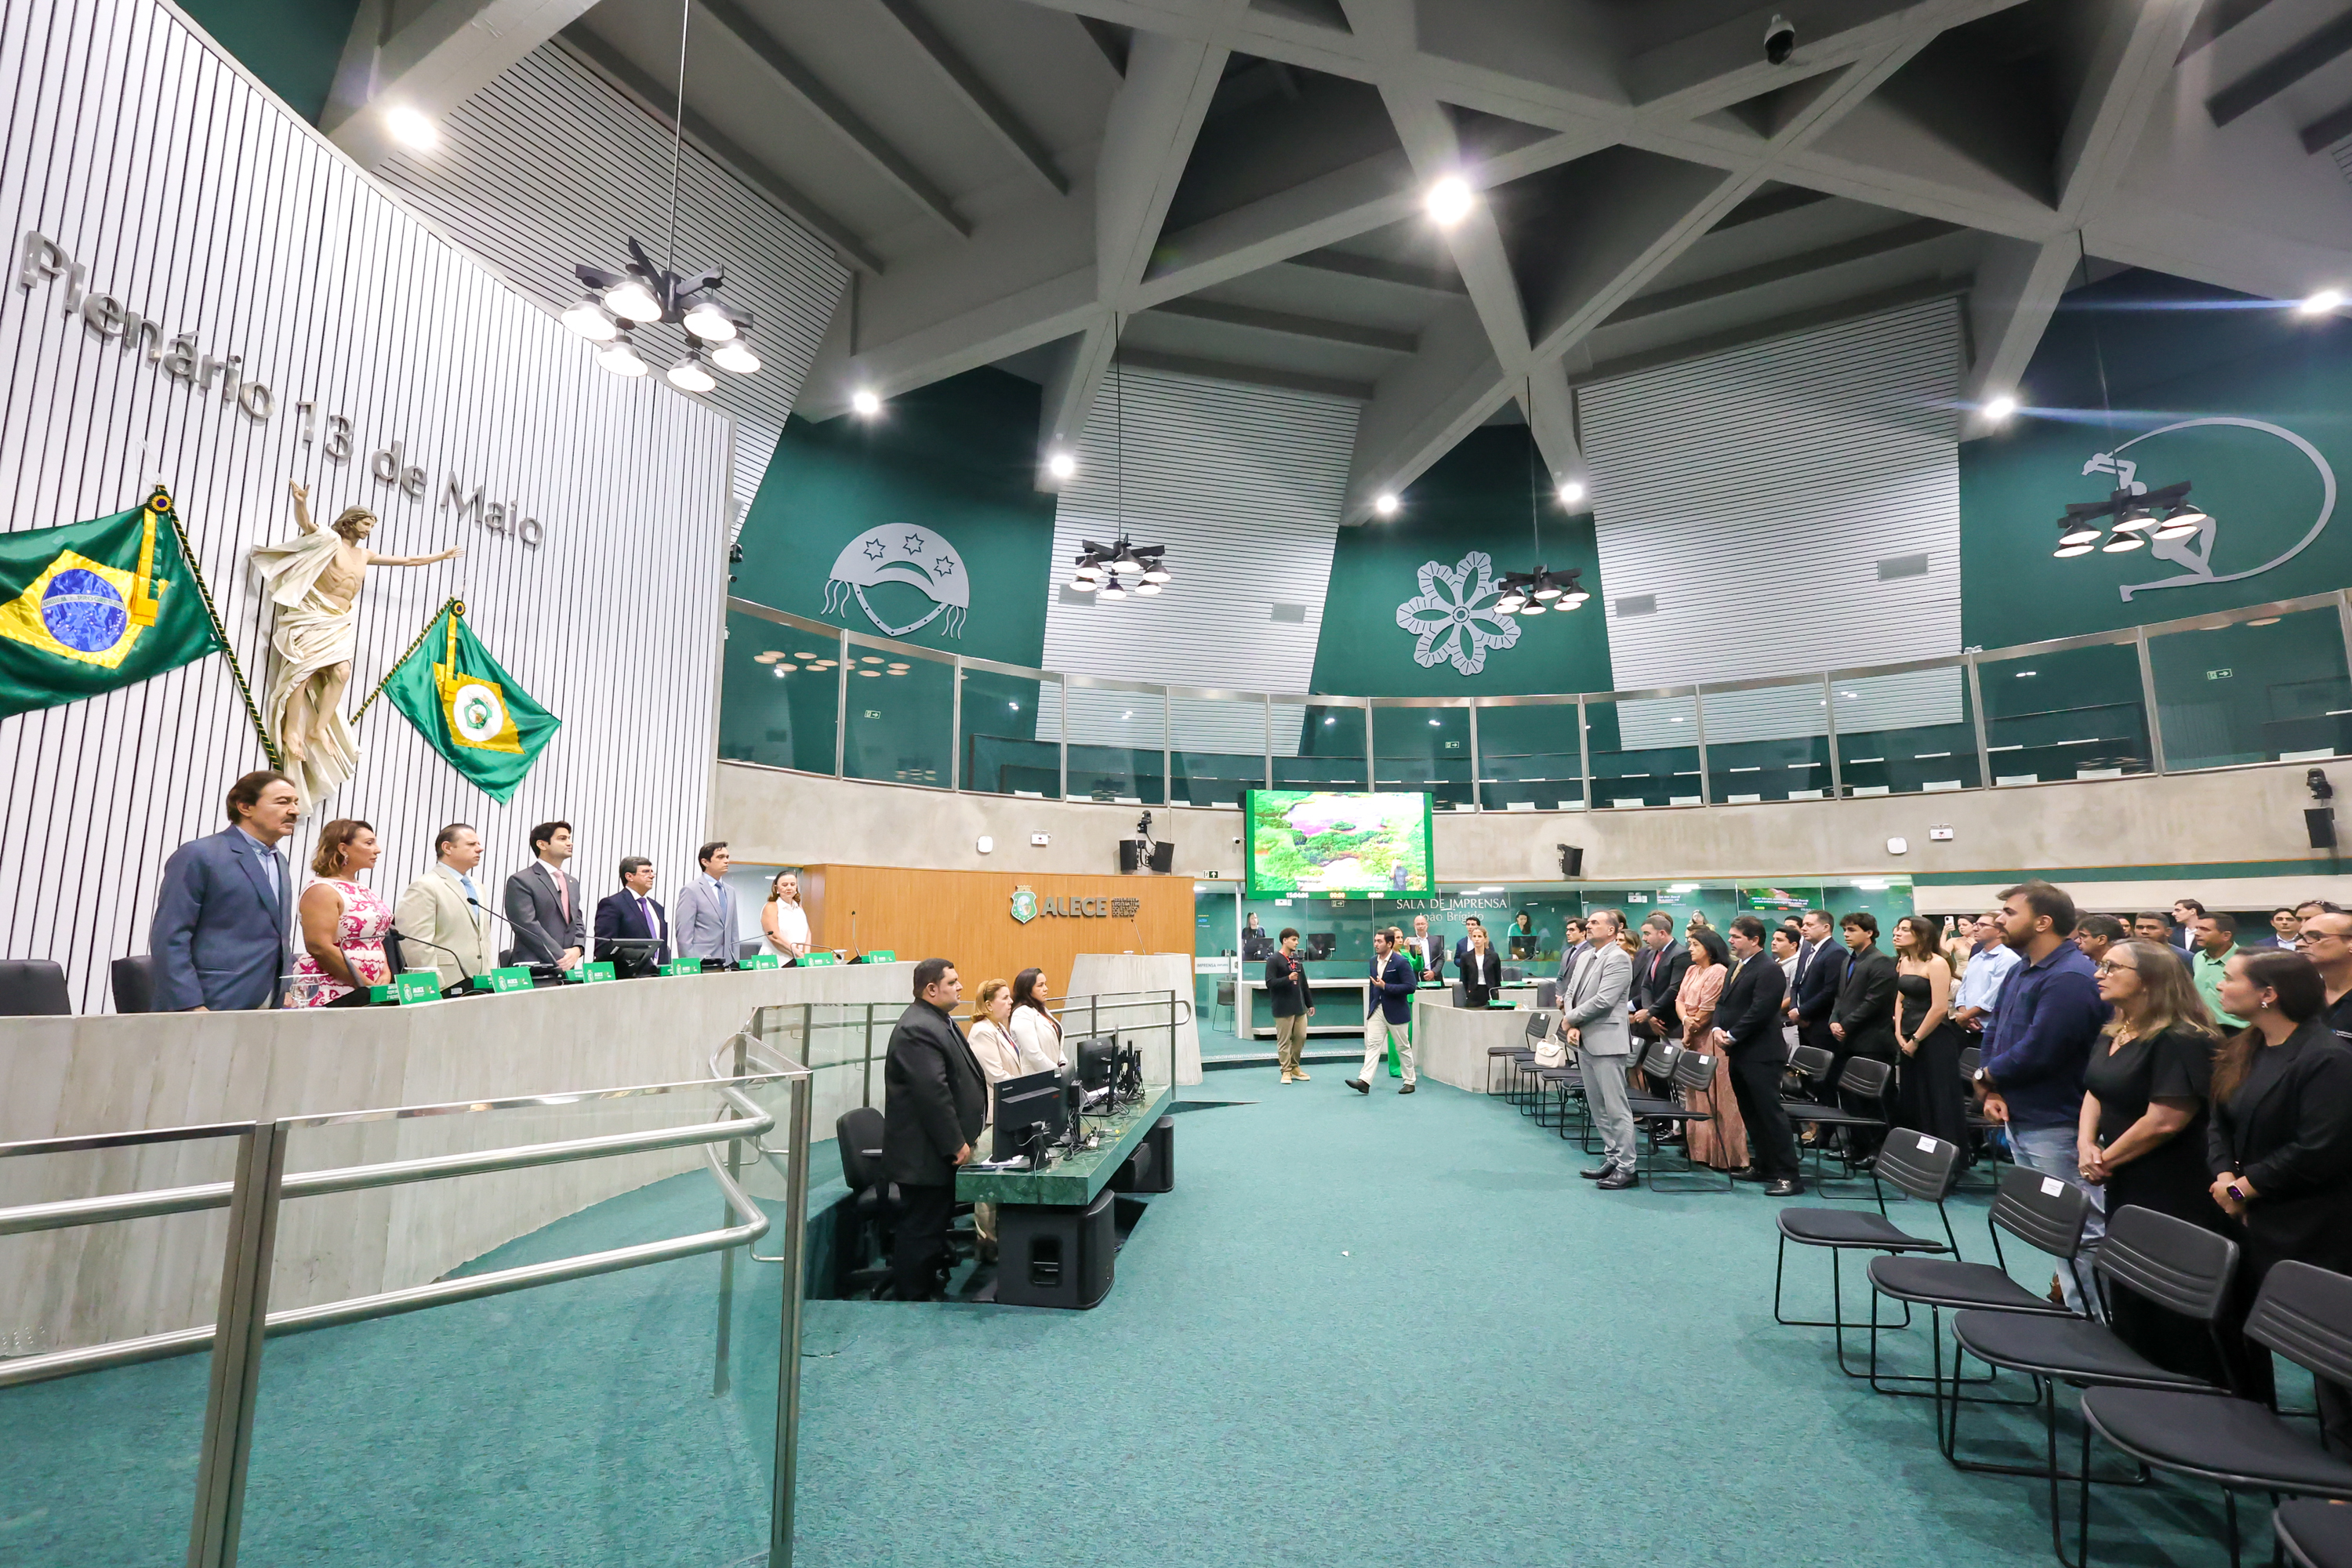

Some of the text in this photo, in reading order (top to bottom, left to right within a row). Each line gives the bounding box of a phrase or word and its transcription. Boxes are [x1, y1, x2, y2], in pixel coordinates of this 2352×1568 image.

[21, 230, 544, 547] Plenário 13 de Maio
[1040, 896, 1107, 916] ALECE
[1396, 898, 1507, 909] SALA DE IMPRENSA
[1420, 912, 1443, 922] oão
